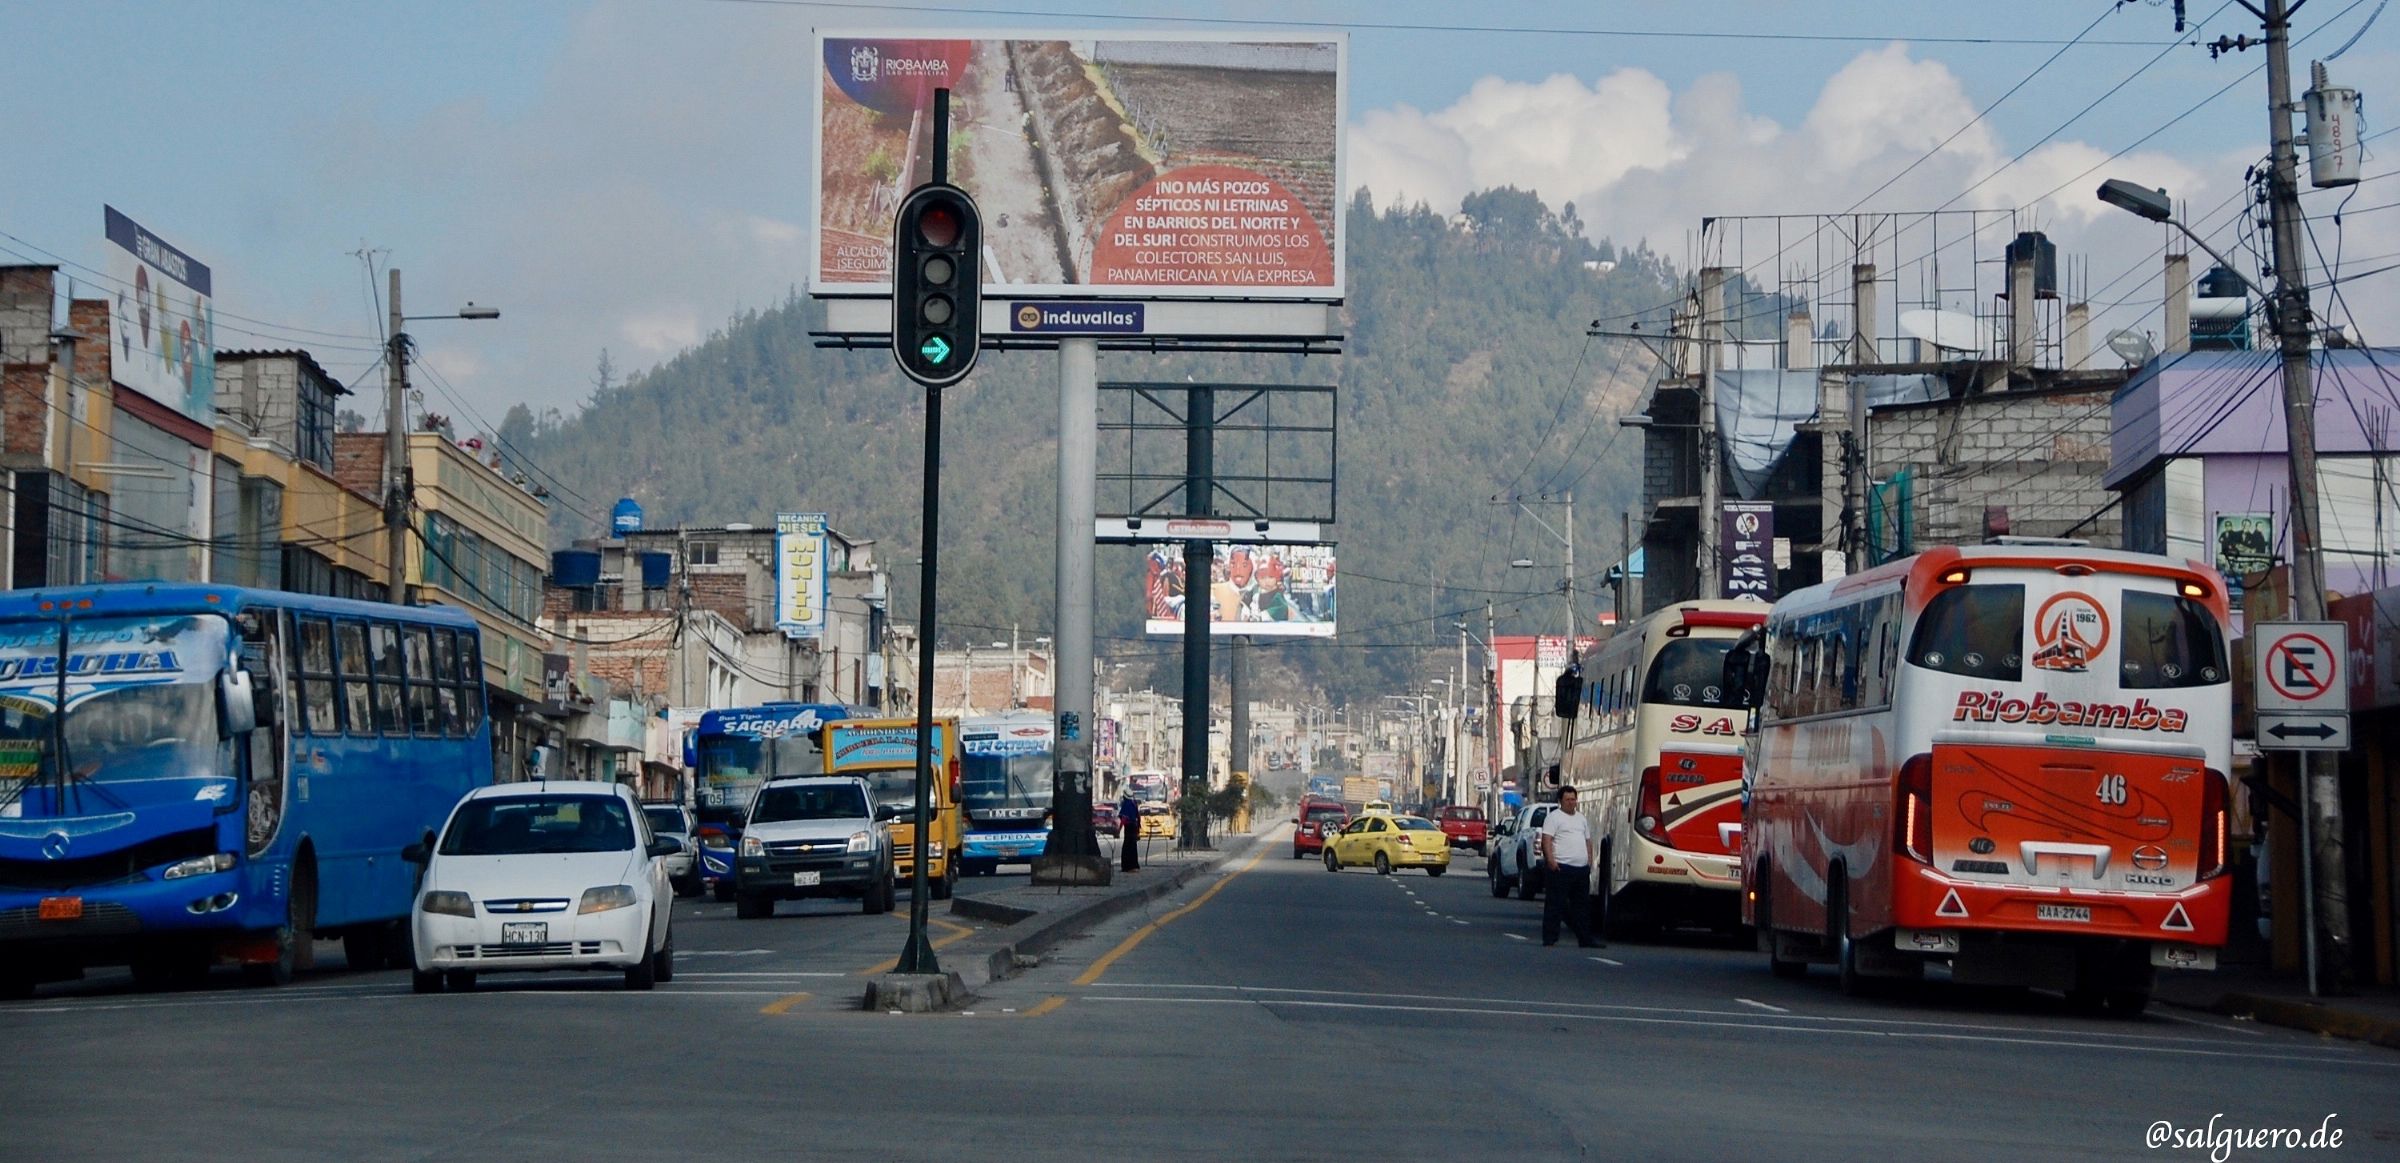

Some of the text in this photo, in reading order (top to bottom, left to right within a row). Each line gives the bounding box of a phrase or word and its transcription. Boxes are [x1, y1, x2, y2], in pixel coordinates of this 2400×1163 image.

[885, 58, 949, 70] RIOBAMBA
[1156, 178, 1270, 195] ¡NO MÁS POZOS
[1135, 196, 1289, 212] SÉPTICOS NI LETRINAS
[1124, 216, 1300, 230] EN BARRIOS DEL NORTE Y
[1114, 234, 1310, 248] DEL SUR! CONSTRUIMOS LOS
[836, 245, 891, 258] ALCALDÍA
[1135, 251, 1287, 267] COLECTORES SAN LUIS,
[1108, 267, 1316, 283] PANAMERICANA Y VÍA EXPRESA
[1043, 311, 1133, 325] induvallas
[778, 523, 825, 533] DIESEL
[2076, 614, 2097, 623] 1962
[2285, 647, 2316, 688] E
[1953, 690, 2188, 732] Riobamba
[723, 709, 823, 733] SAGRARIO
[1671, 714, 1747, 737] SA
[2096, 773, 2127, 805] 46
[709, 795, 722, 804] 05
[2126, 874, 2175, 886] HINO
[2037, 904, 2090, 921] HAA-2744
